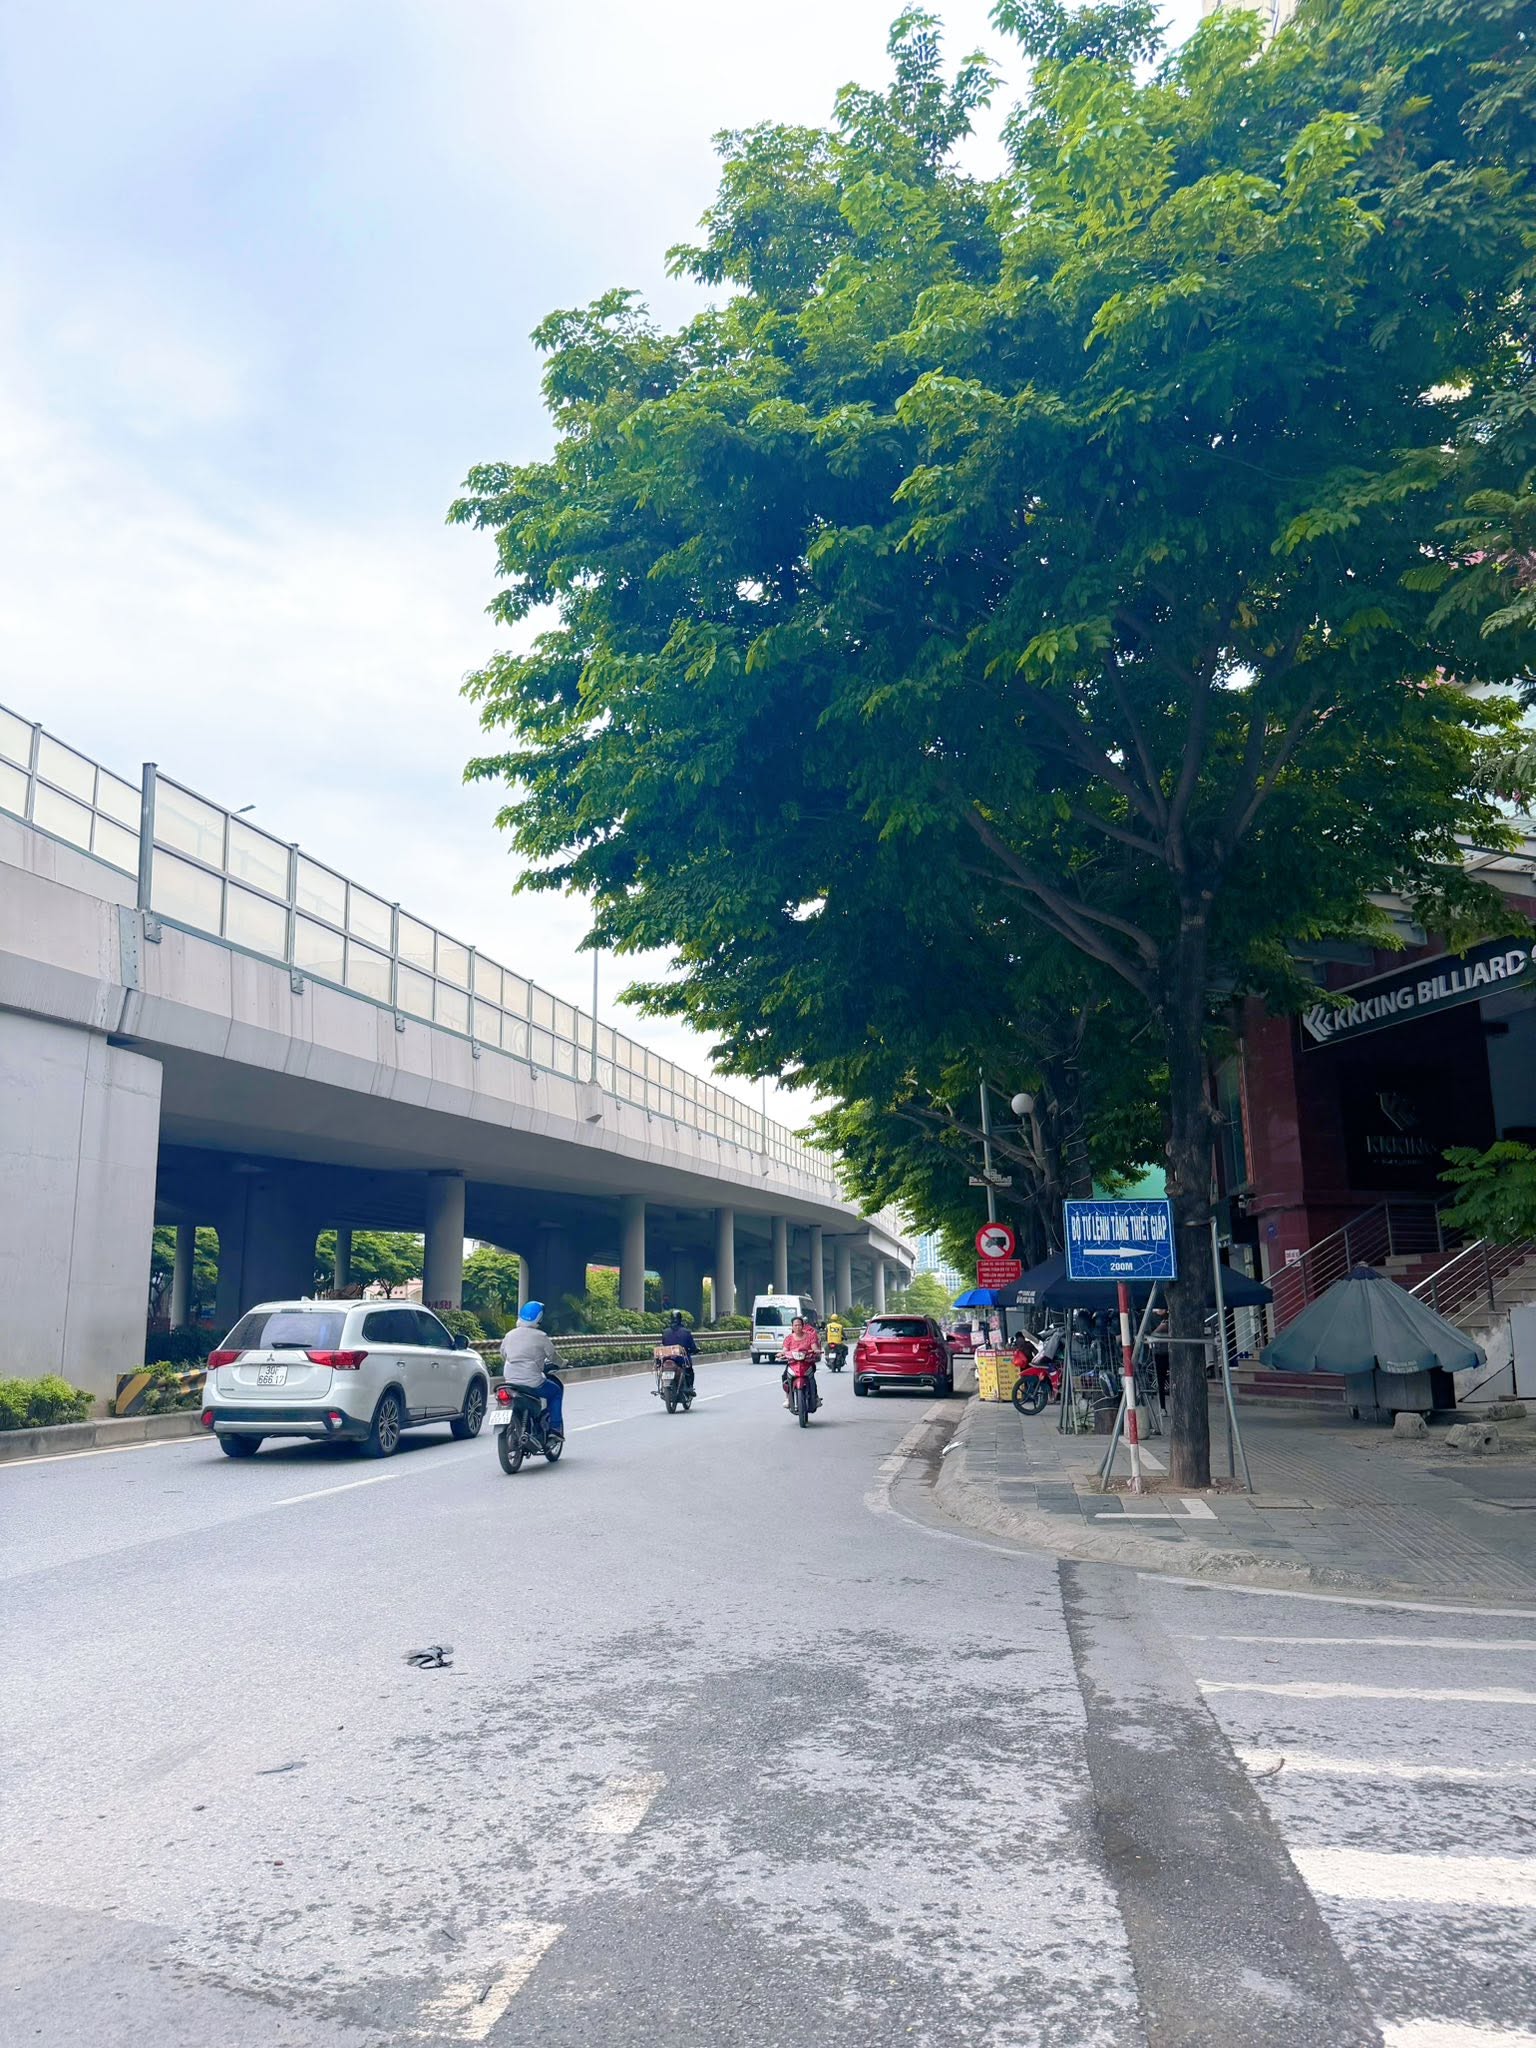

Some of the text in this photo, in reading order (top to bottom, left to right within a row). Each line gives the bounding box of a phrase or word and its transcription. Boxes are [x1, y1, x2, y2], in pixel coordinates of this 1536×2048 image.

[1417, 949, 1528, 1005] BILLIARD
[1071, 1211, 1081, 1245] BỘ
[1082, 1213, 1091, 1241] TƯ
[1092, 1211, 1110, 1245] LỆNH
[1130, 1208, 1149, 1241] THIẾT
[1150, 1210, 1167, 1241] GIÁP
[1110, 1262, 1133, 1271] 200M
